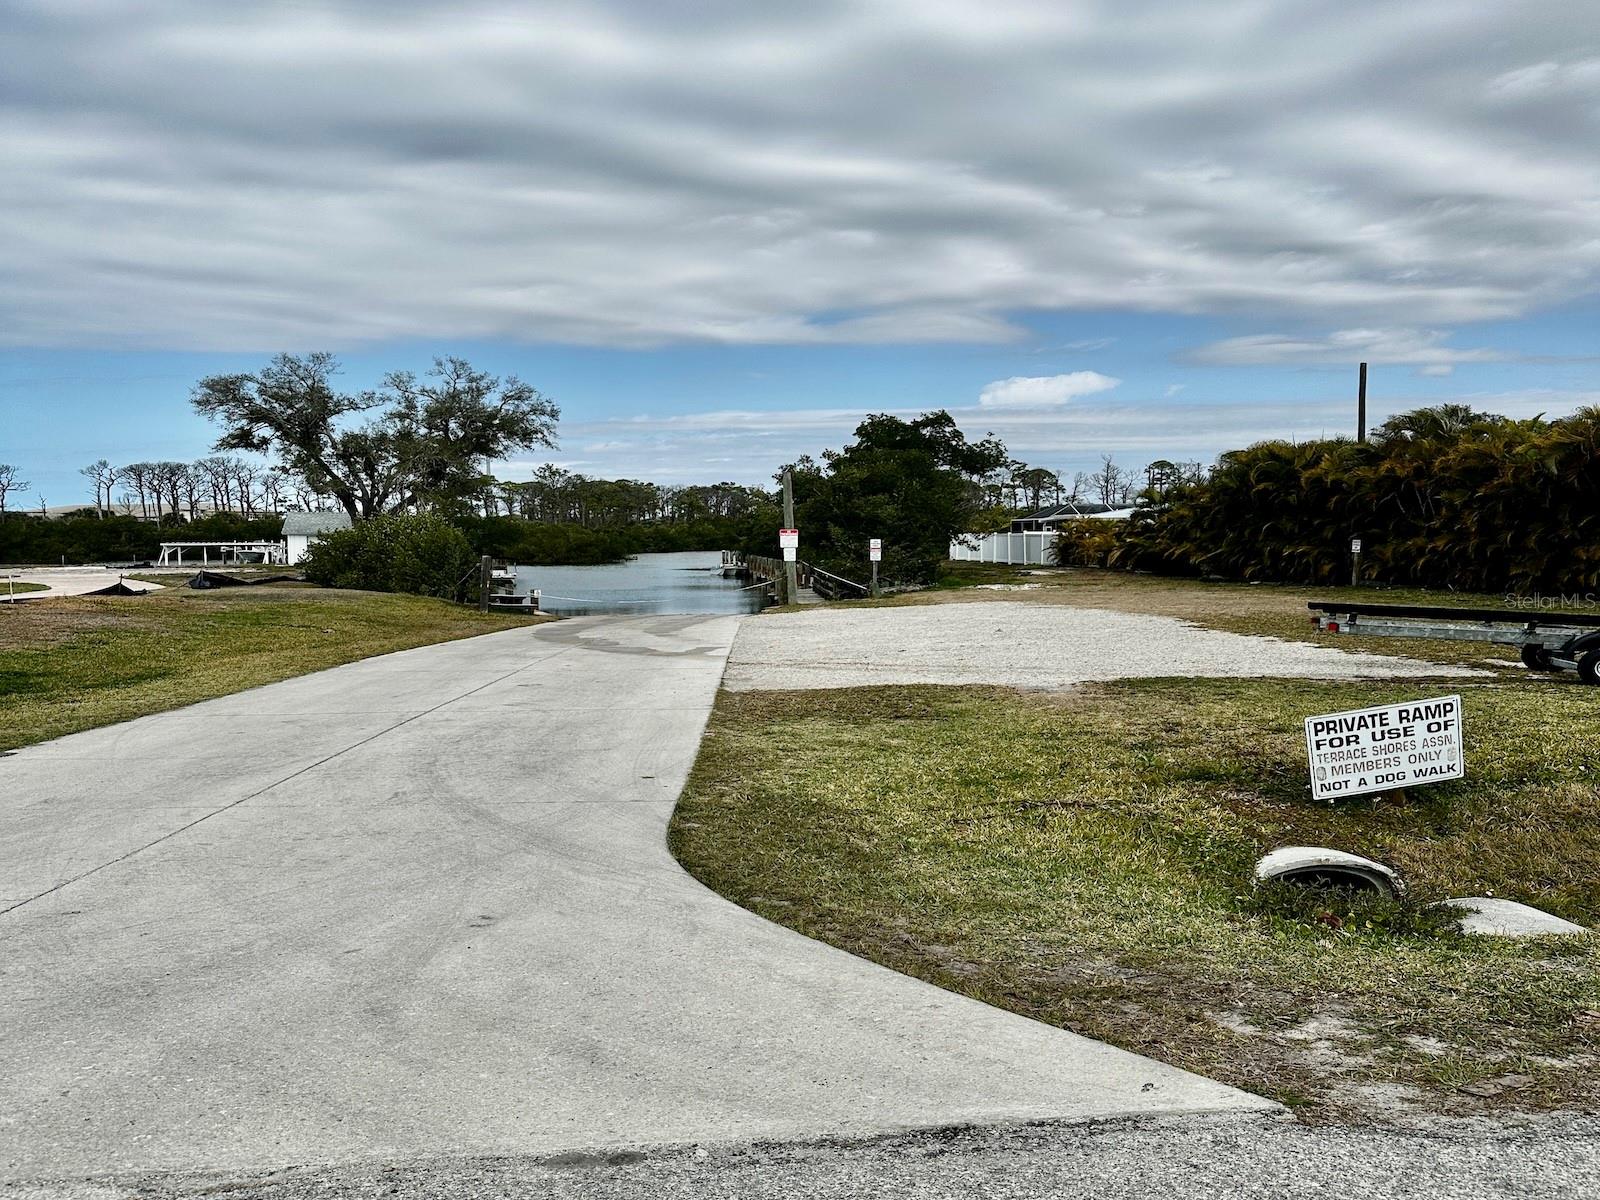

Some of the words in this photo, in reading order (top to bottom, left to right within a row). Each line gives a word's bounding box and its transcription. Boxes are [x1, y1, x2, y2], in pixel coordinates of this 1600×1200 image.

[1313, 711, 1390, 737] PRIVATE
[1398, 702, 1454, 724] RAMP
[1315, 734, 1360, 751] FOR
[1371, 725, 1415, 742] USE
[1426, 719, 1455, 733] OF
[1317, 747, 1368, 764] TERRACE
[1372, 740, 1417, 756] SHORES
[1422, 734, 1456, 749] ASSN.
[1320, 779, 1351, 792] NOT
[1358, 777, 1368, 787] A
[1375, 771, 1406, 785] DOG
[1413, 763, 1457, 778] WALK
[1331, 756, 1401, 776] MEMBERS
[1408, 750, 1442, 764] ONLY
